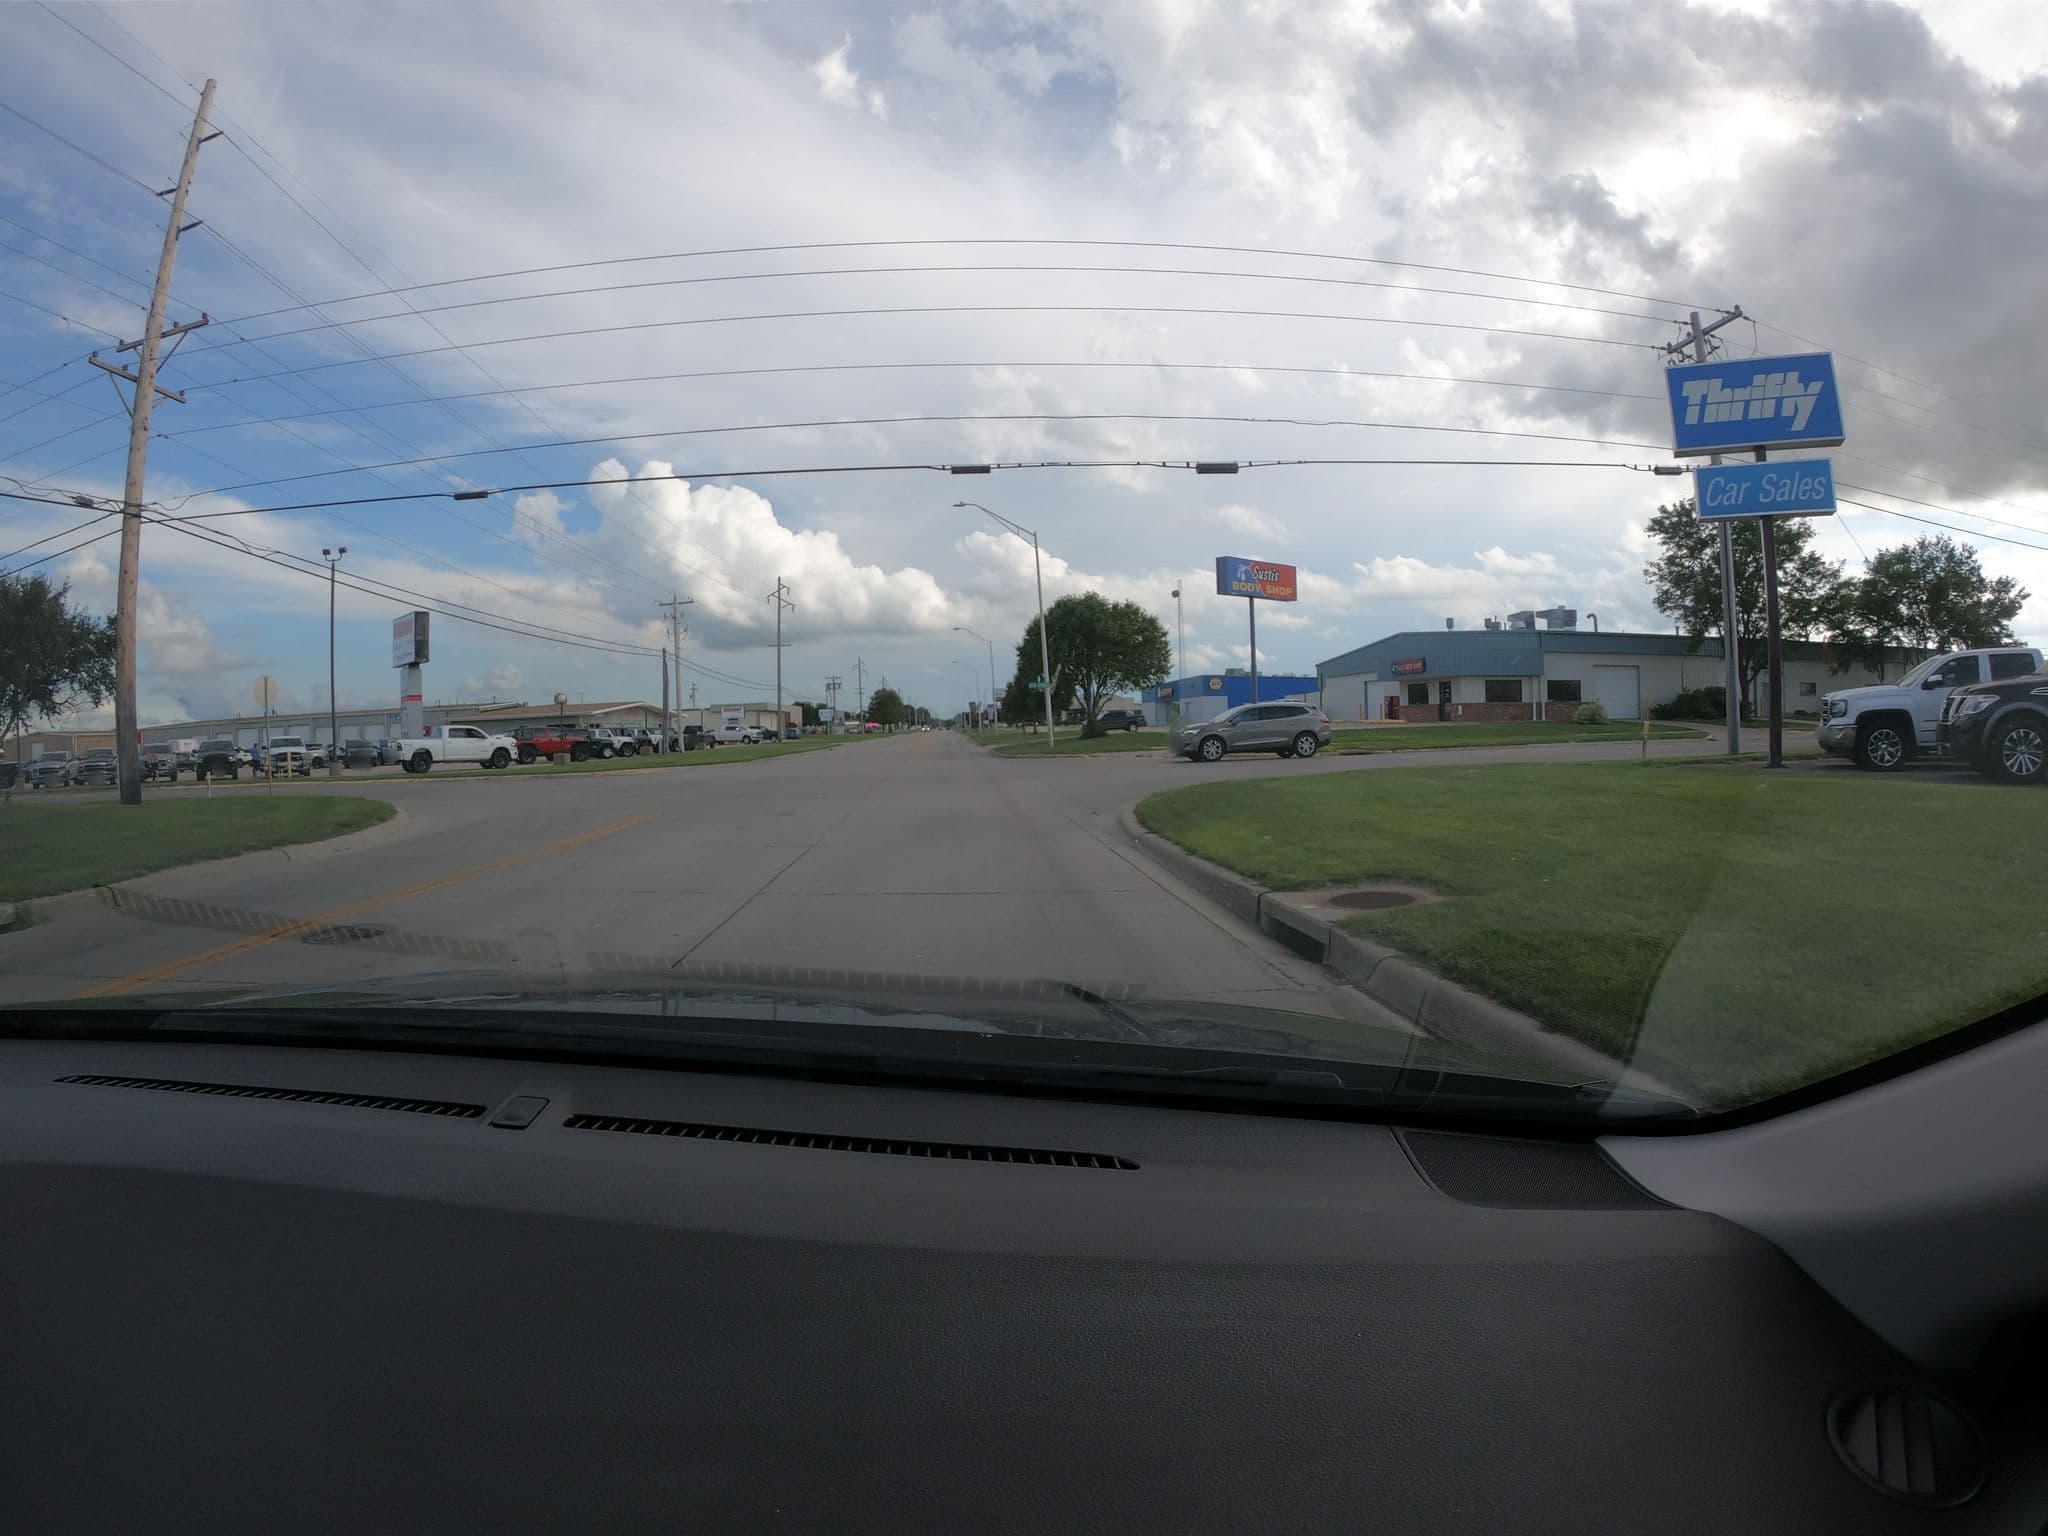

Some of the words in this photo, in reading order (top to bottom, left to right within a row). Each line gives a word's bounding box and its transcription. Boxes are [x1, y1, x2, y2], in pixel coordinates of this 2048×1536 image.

[1682, 371, 1823, 431] Thrifty
[1706, 477, 1750, 506] Car
[1759, 472, 1826, 503] Sales
[1232, 582, 1261, 593] BODY
[1266, 585, 1293, 597] SHOP
